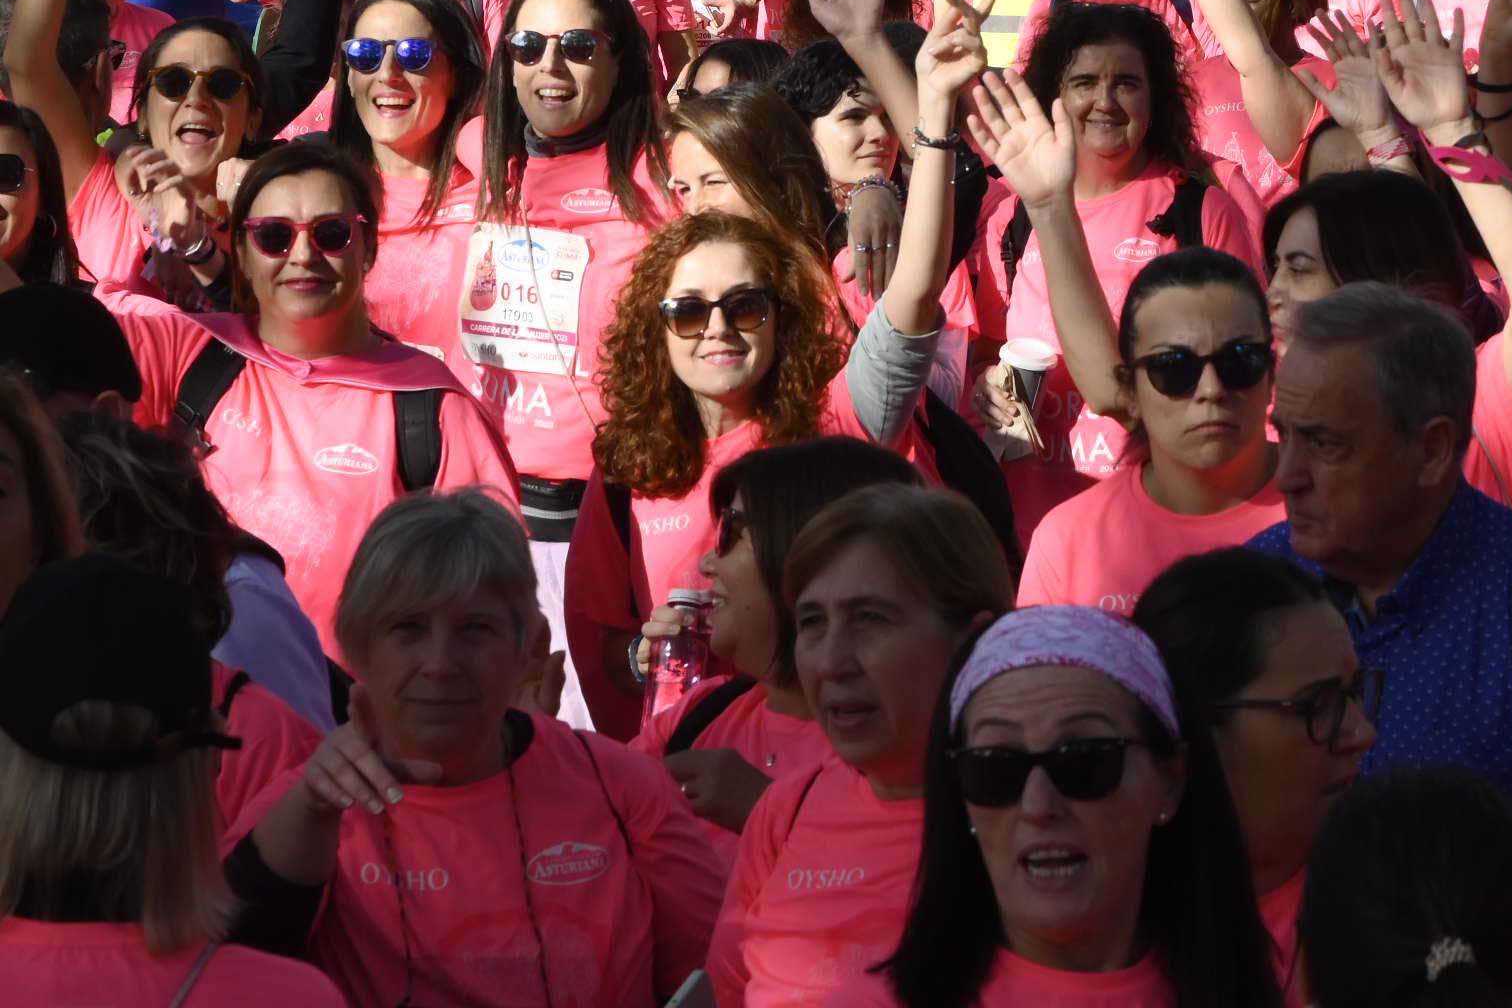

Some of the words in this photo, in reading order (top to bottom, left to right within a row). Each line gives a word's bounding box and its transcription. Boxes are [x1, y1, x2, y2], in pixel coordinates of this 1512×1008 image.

[1204, 100, 1246, 116] OYSHO
[501, 282, 539, 305] 016
[502, 308, 535, 323] 17903
[470, 323, 500, 336] CARRERA
[470, 366, 552, 417] SUMA
[1044, 431, 1115, 463] UMA
[641, 513, 690, 536] YSHO
